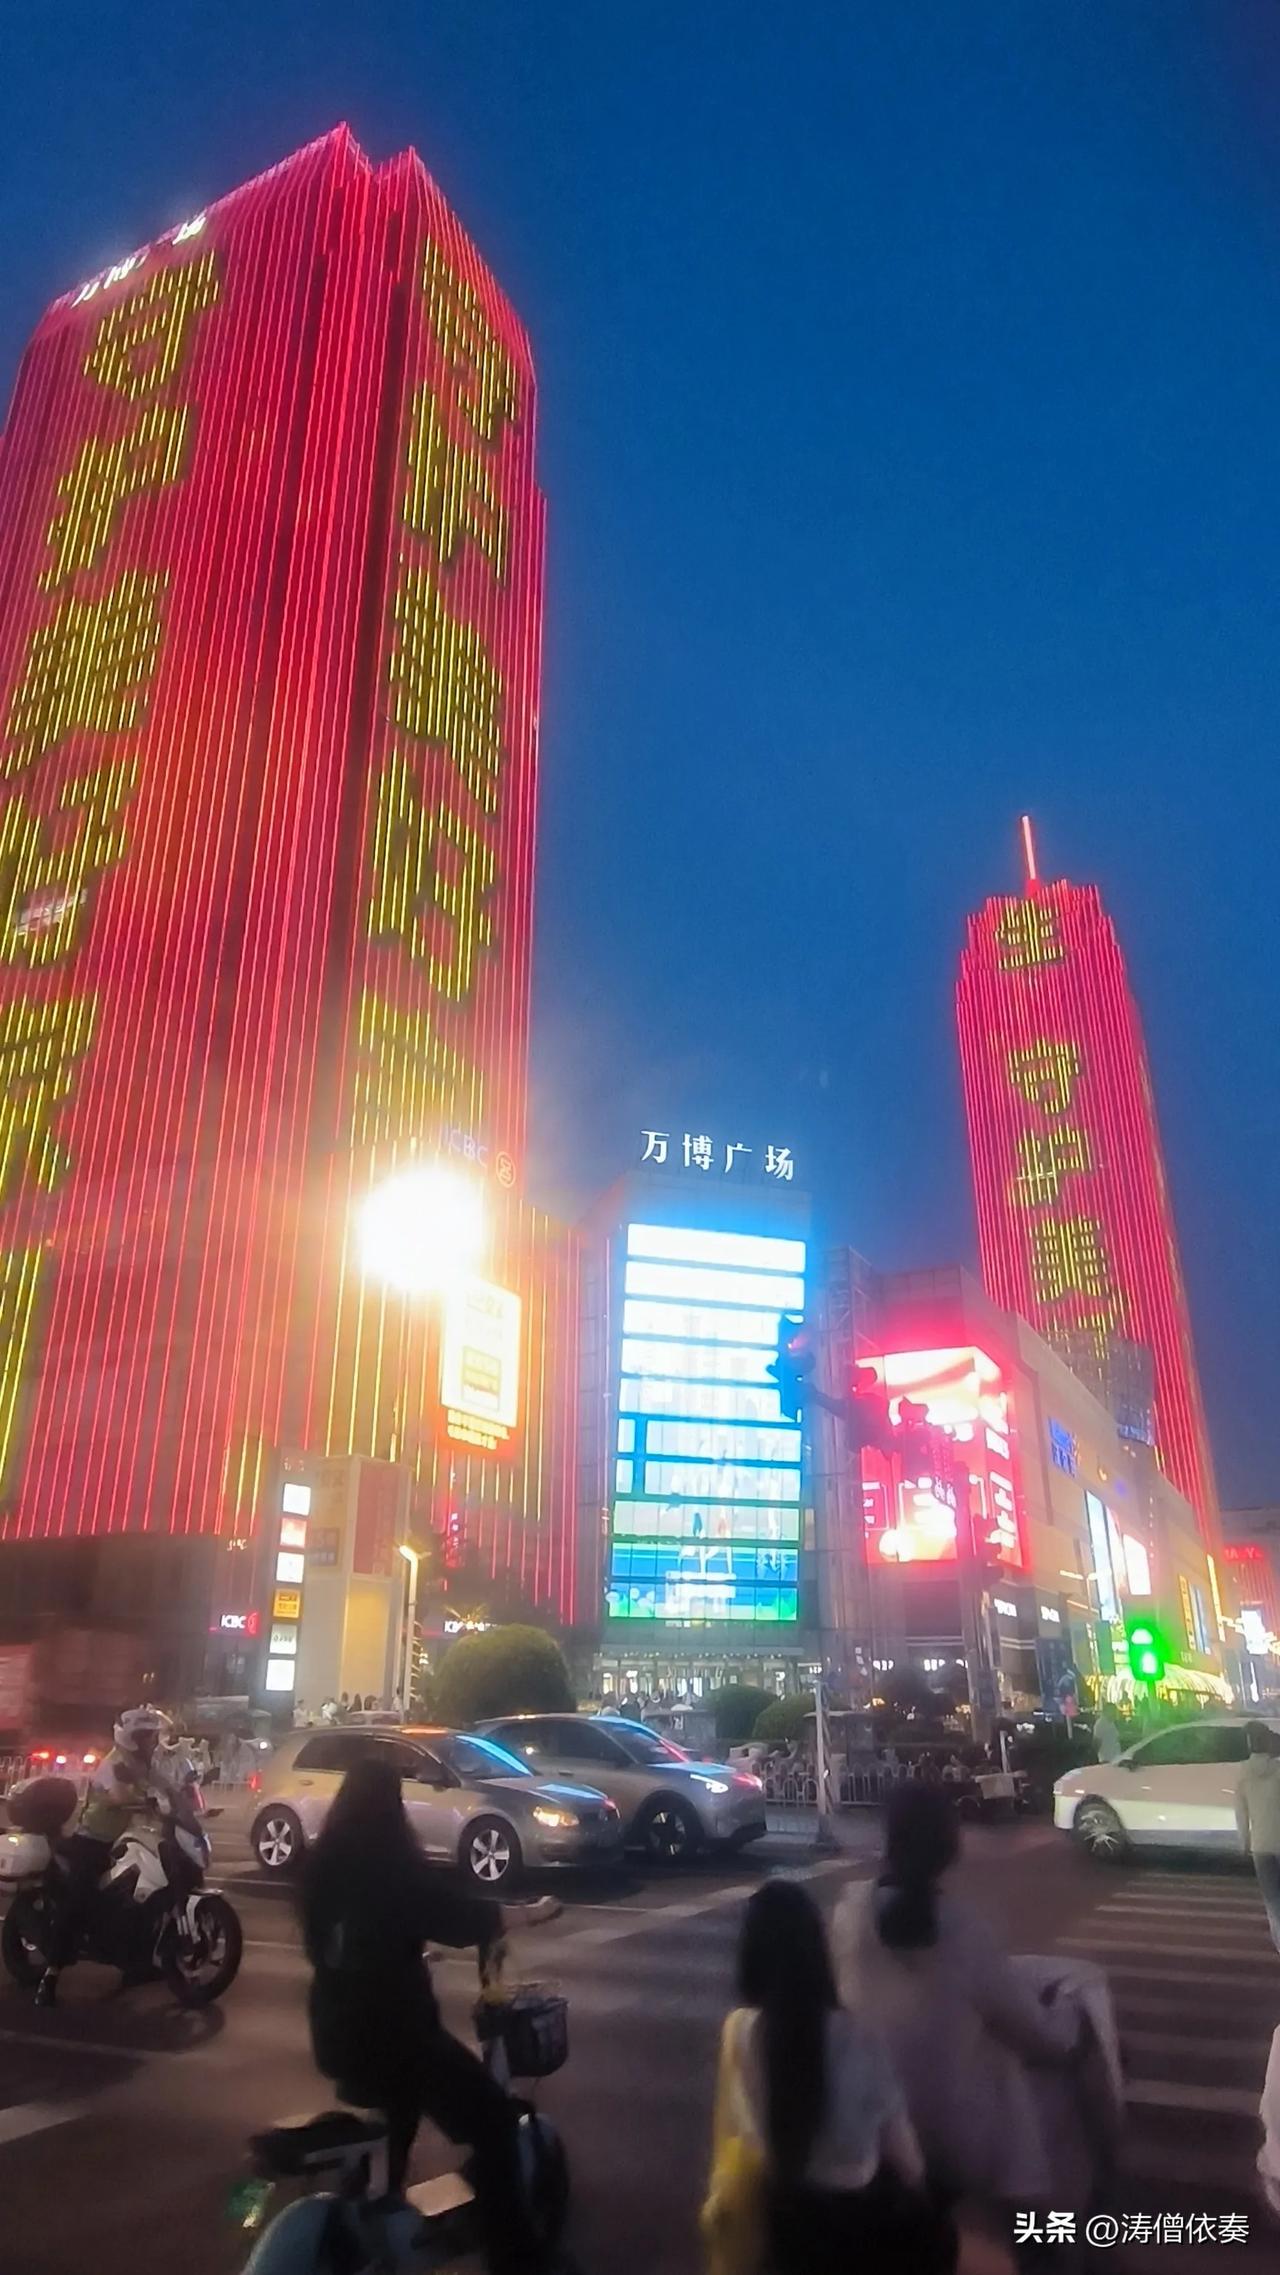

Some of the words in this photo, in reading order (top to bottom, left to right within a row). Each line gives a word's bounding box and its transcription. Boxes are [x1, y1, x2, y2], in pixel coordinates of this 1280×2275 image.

[443, 1125, 489, 1168] ICBC
[640, 1129, 795, 1181] 万博广场
[220, 1614, 247, 1629] ICBC
